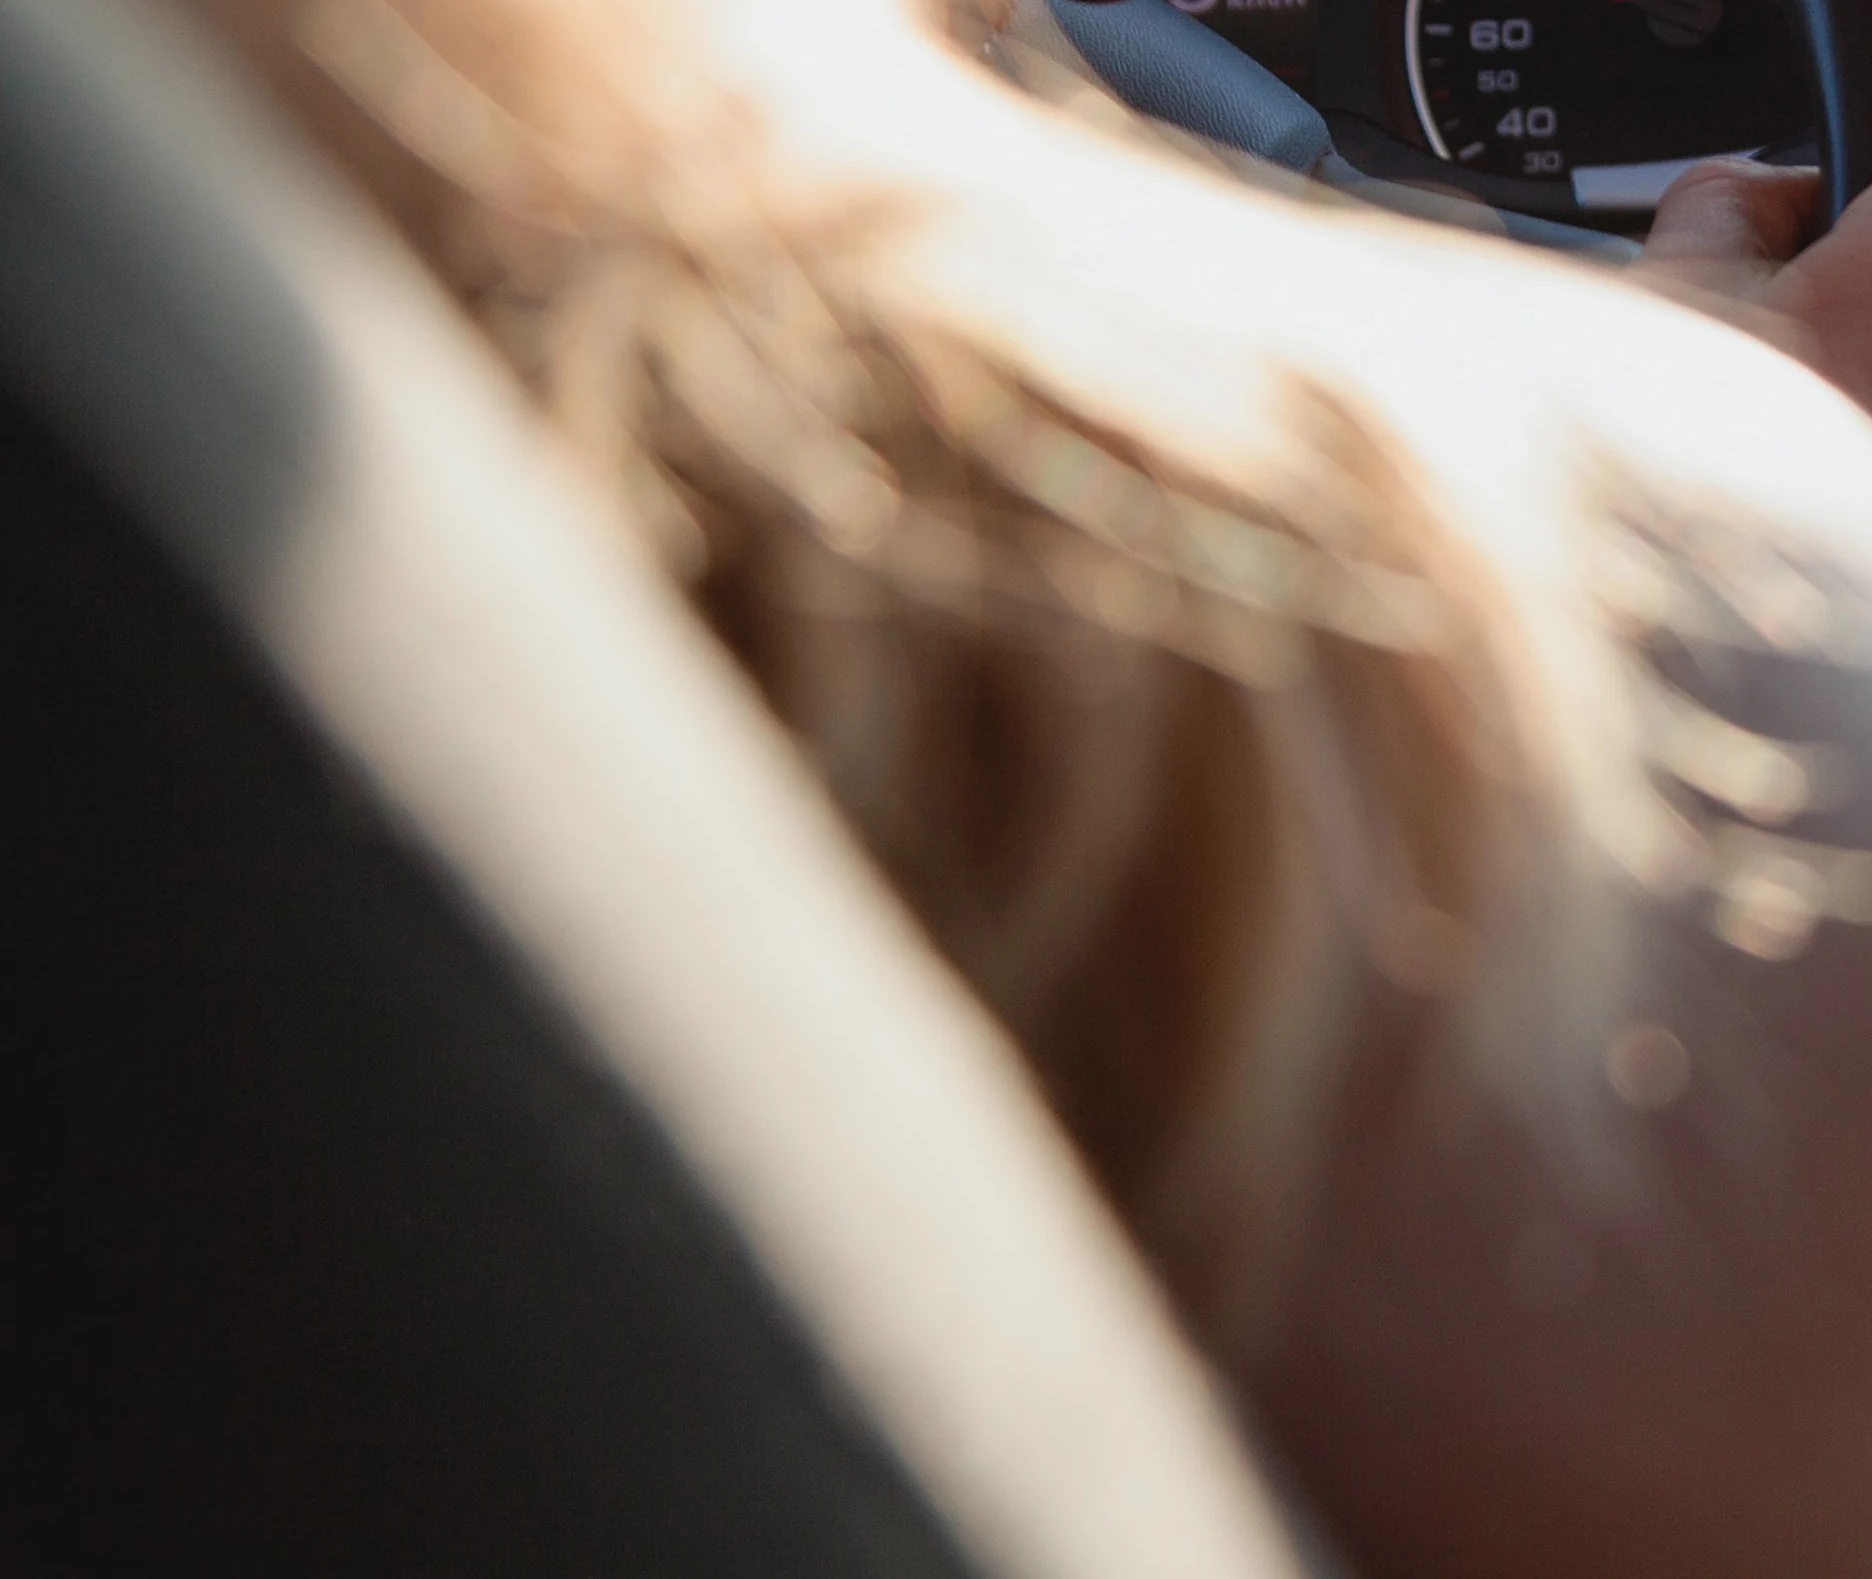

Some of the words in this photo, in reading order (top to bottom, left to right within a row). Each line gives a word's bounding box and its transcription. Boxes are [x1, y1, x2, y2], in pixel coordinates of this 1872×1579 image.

[1469, 18, 1533, 51] 60
[1476, 69, 1519, 93] 50
[1496, 106, 1557, 138] 40
[1524, 151, 1563, 174] 30
